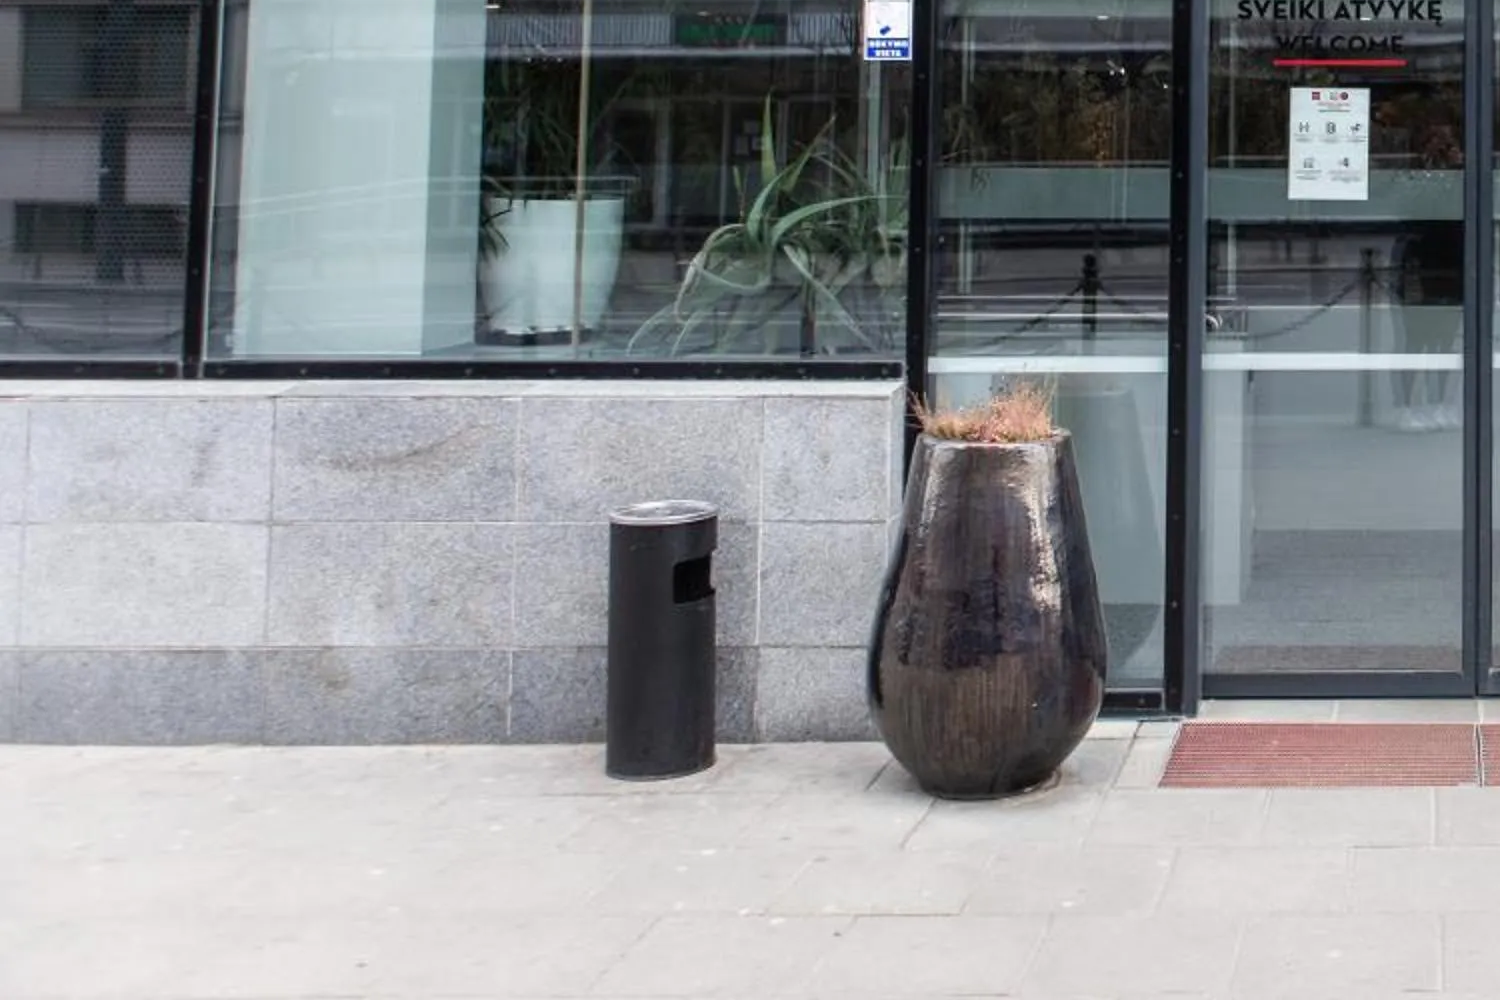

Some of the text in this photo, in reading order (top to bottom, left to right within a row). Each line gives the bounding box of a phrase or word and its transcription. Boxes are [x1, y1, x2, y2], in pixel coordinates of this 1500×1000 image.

[1237, 0, 1444, 26] SVEIKI ATVYKĘ
[1276, 35, 1404, 53] WELCOME
